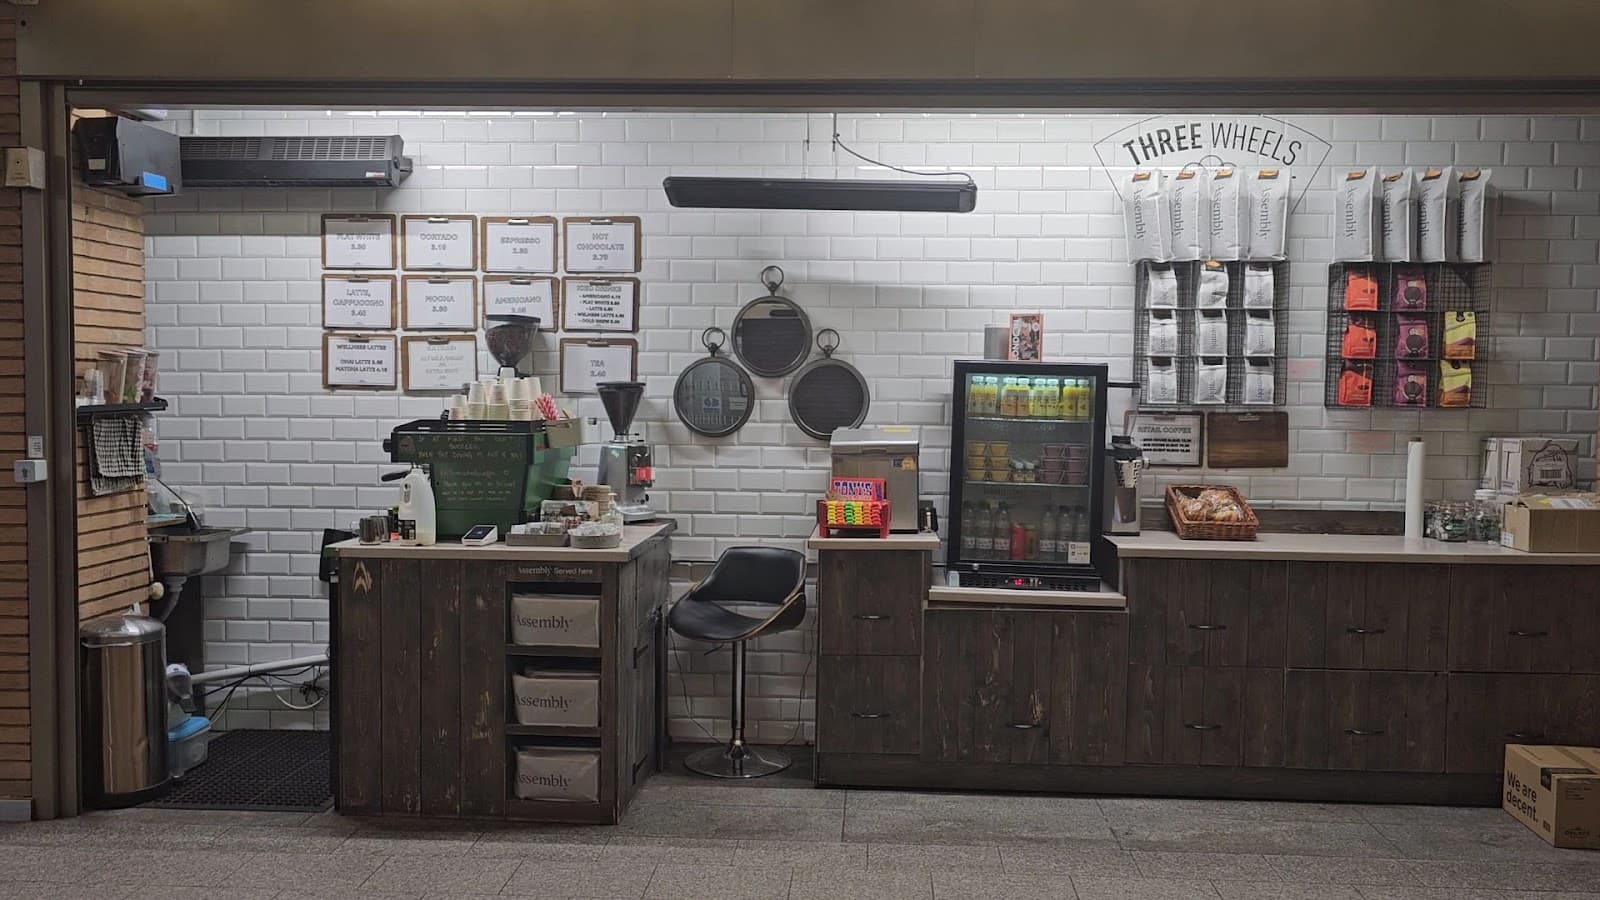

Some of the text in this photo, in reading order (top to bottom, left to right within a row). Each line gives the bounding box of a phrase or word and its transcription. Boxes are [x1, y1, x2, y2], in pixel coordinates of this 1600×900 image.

[1122, 121, 1302, 166] THREE WHEELS
[1132, 187, 1145, 241] Assembly
[1172, 186, 1185, 241] Assembly
[1211, 186, 1225, 239] Assembly
[1255, 187, 1273, 240] Assembly
[1345, 187, 1357, 239] Assembly
[420, 233, 458, 241] CORTADO
[500, 236, 541, 244] ESPRESSO
[576, 243, 625, 251] CHOCOLATE
[592, 232, 609, 240] HOT
[424, 295, 455, 303] MOCHA
[495, 295, 542, 304] AMERICANO
[553, 567, 577, 575] Served
[578, 567, 593, 575] here
[518, 773, 571, 791] ssembly
[1507, 769, 1537, 803] We are
[1506, 790, 1539, 823] decent.
